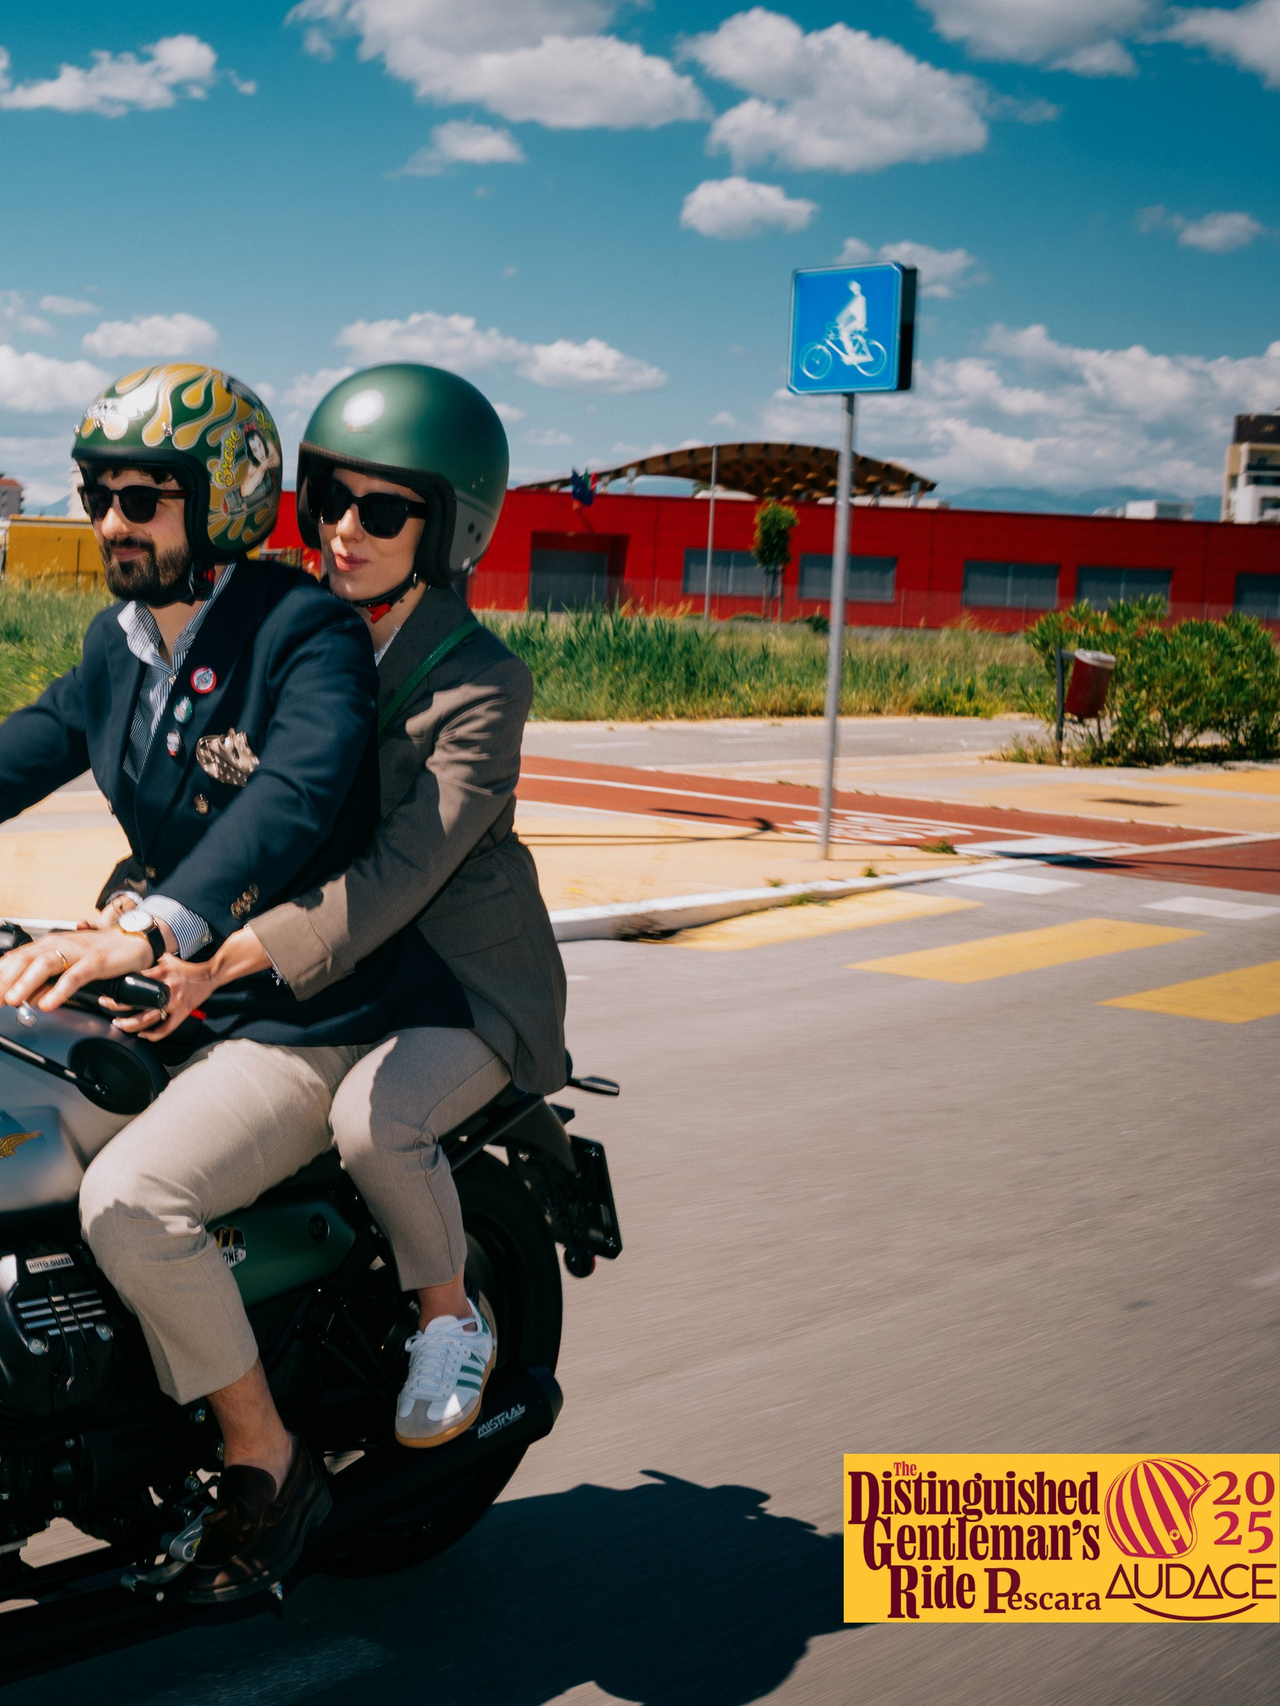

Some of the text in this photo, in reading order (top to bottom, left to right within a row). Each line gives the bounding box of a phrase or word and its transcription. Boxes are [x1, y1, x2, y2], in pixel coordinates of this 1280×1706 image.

[215, 429, 240, 487] Brave
[28, 1256, 73, 1271] MOTO GUZZI
[477, 1403, 526, 1439] MISTRAL
